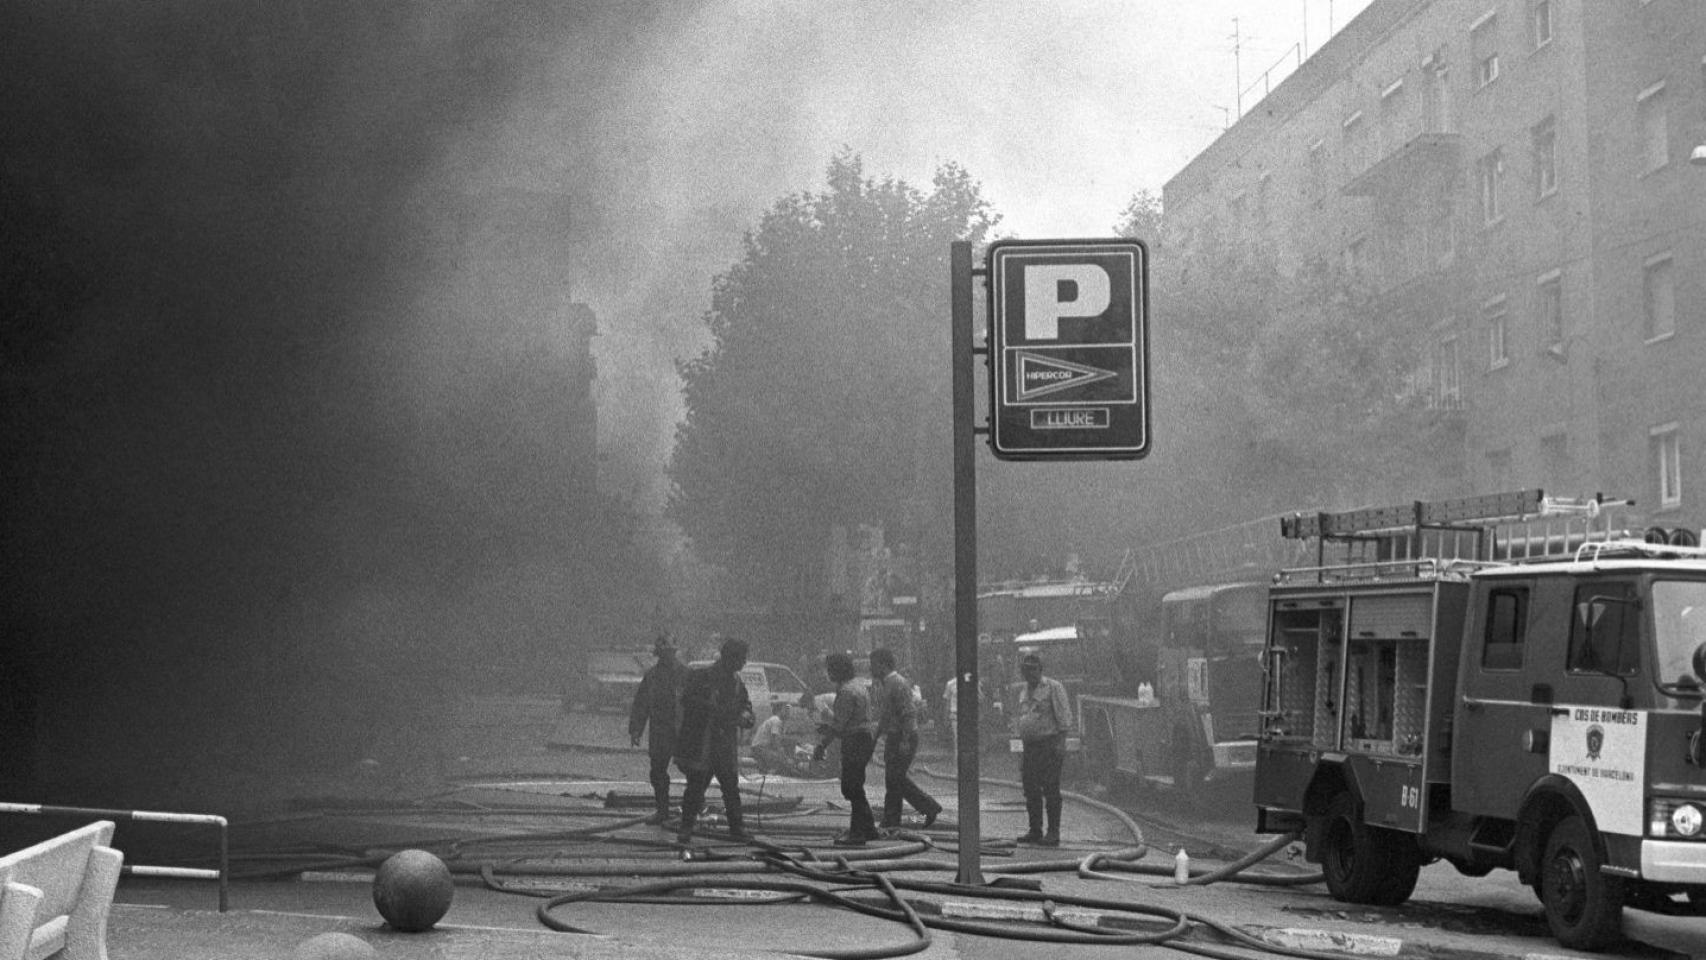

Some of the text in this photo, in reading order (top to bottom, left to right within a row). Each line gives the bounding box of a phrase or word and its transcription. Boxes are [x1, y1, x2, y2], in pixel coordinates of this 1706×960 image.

[1024, 264, 1110, 340] P
[1027, 371, 1072, 380] HIPERCOR
[1048, 411, 1094, 425] LLIURE
[1575, 708, 1638, 725] COS DE BOMBERS
